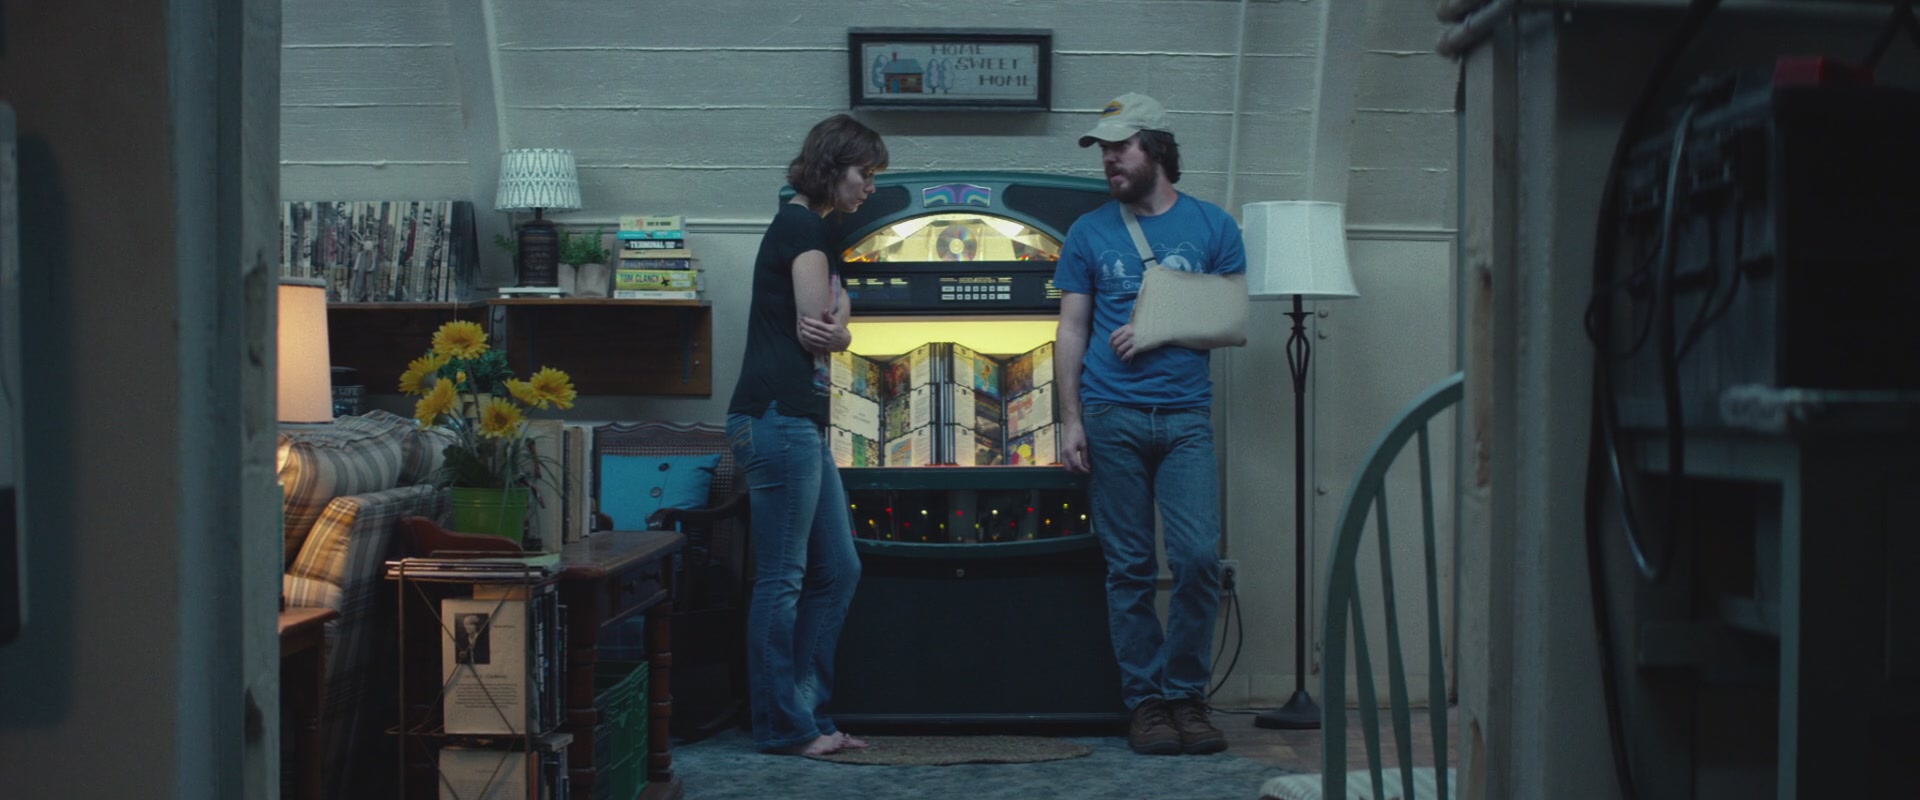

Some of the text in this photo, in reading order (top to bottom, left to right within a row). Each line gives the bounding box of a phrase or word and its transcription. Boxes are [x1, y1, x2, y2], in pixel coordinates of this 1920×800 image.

[931, 44, 984, 55] HOME
[955, 57, 1020, 70] SWEET
[980, 75, 1030, 86] HOME
[630, 241, 664, 249] TERMINAL
[621, 274, 660, 283] TOM CLANCY
